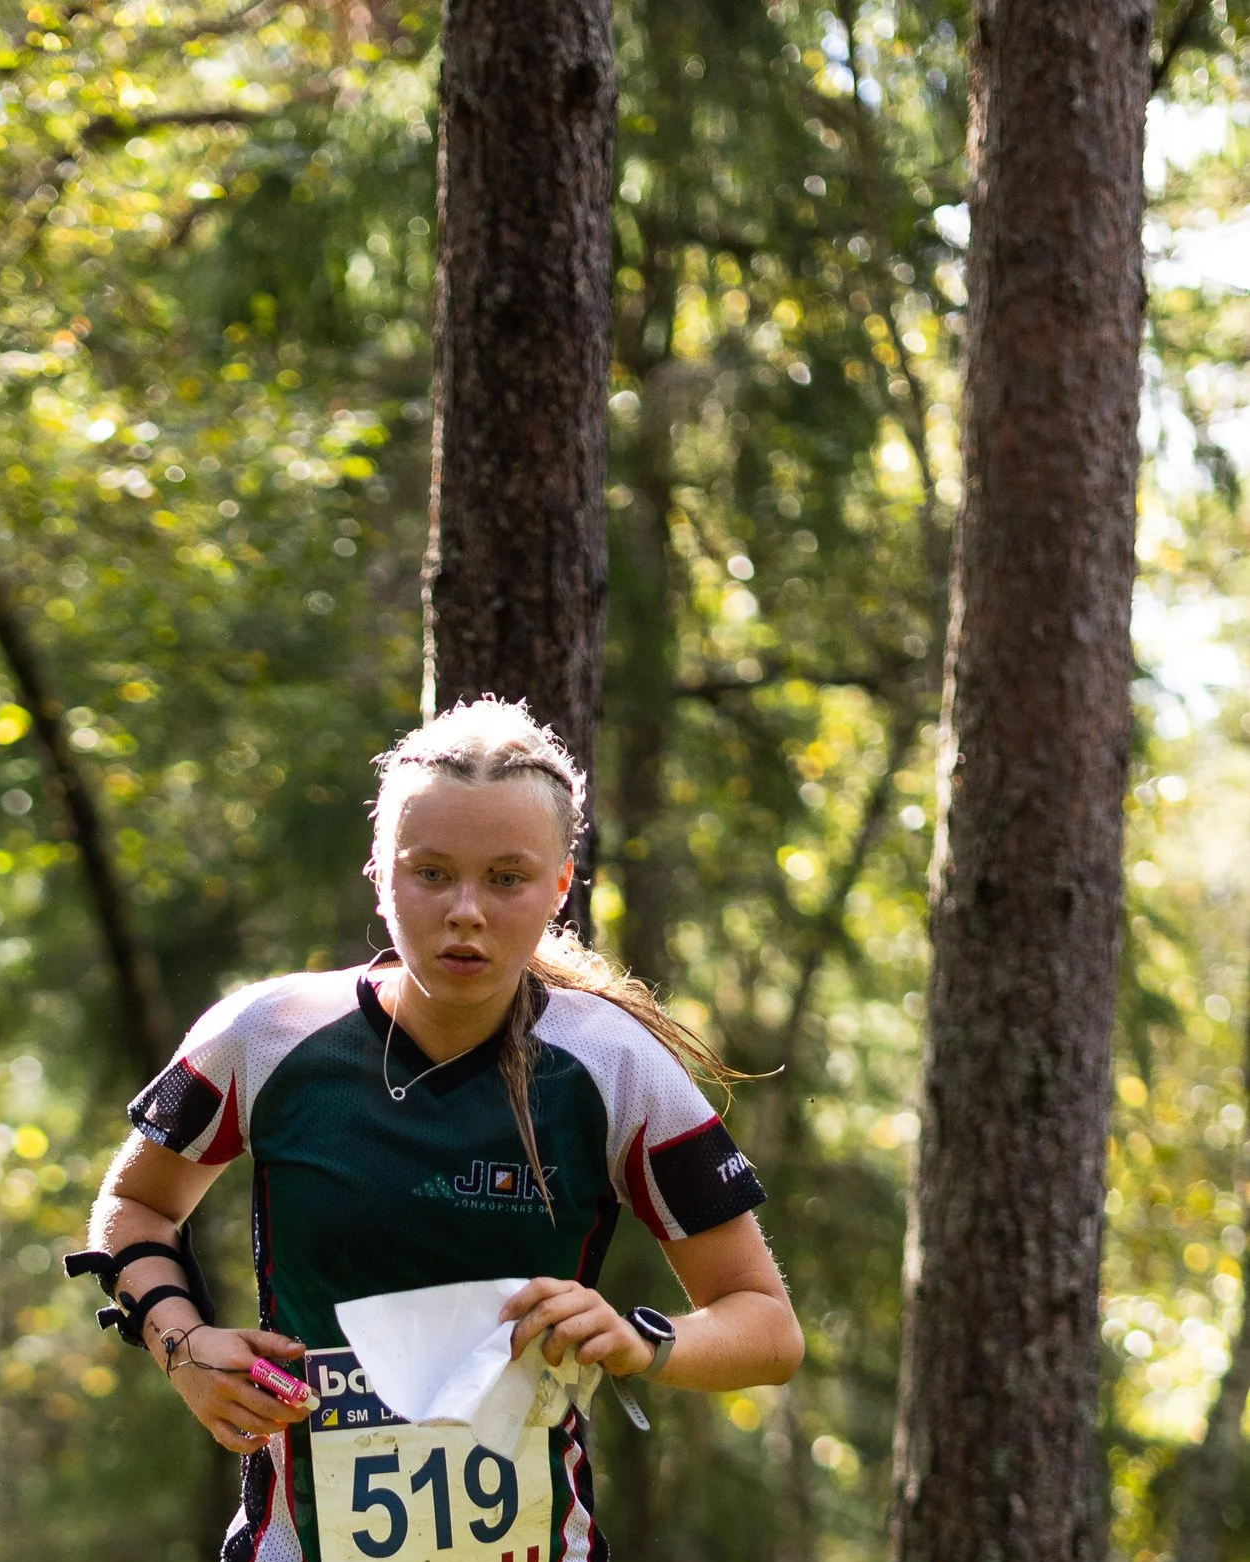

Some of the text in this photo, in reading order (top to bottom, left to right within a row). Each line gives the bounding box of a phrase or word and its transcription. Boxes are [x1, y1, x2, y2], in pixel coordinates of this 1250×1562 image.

[716, 1150, 749, 1183] TRI
[347, 1409, 368, 1422] SM
[351, 1443, 519, 1559] 519
